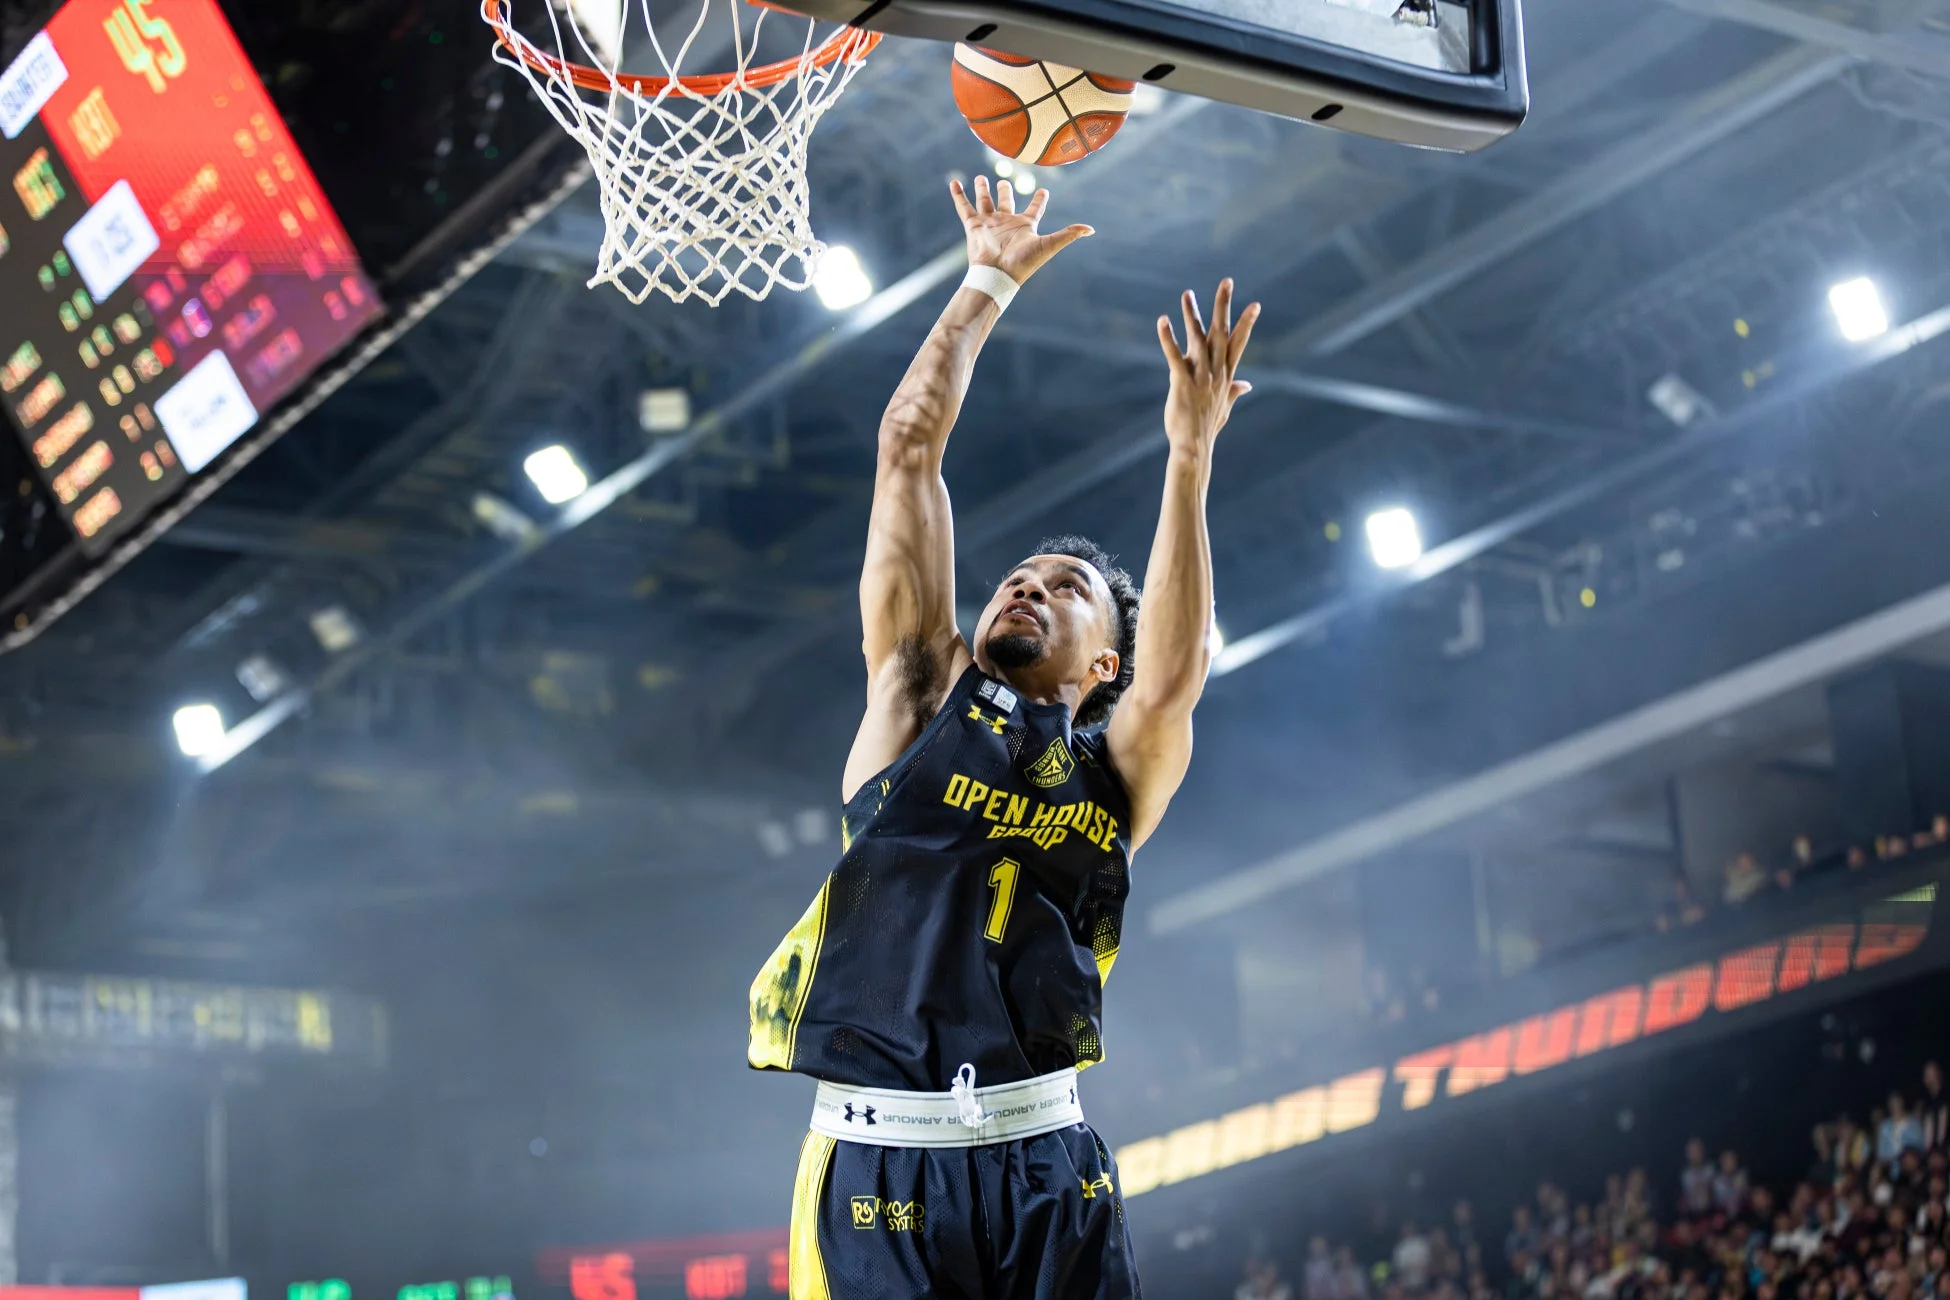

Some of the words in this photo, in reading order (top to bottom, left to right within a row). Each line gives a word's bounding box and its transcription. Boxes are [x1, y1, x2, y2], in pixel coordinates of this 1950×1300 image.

[943, 773, 1029, 826] OPEN
[1030, 800, 1118, 852] HOUSE
[986, 825, 1069, 851] GROUP
[983, 856, 1021, 944] 1
[882, 1113, 943, 1125] ARMOUR
[992, 1103, 1037, 1120] ARMOU
[888, 1215, 925, 1233] SYSTS
